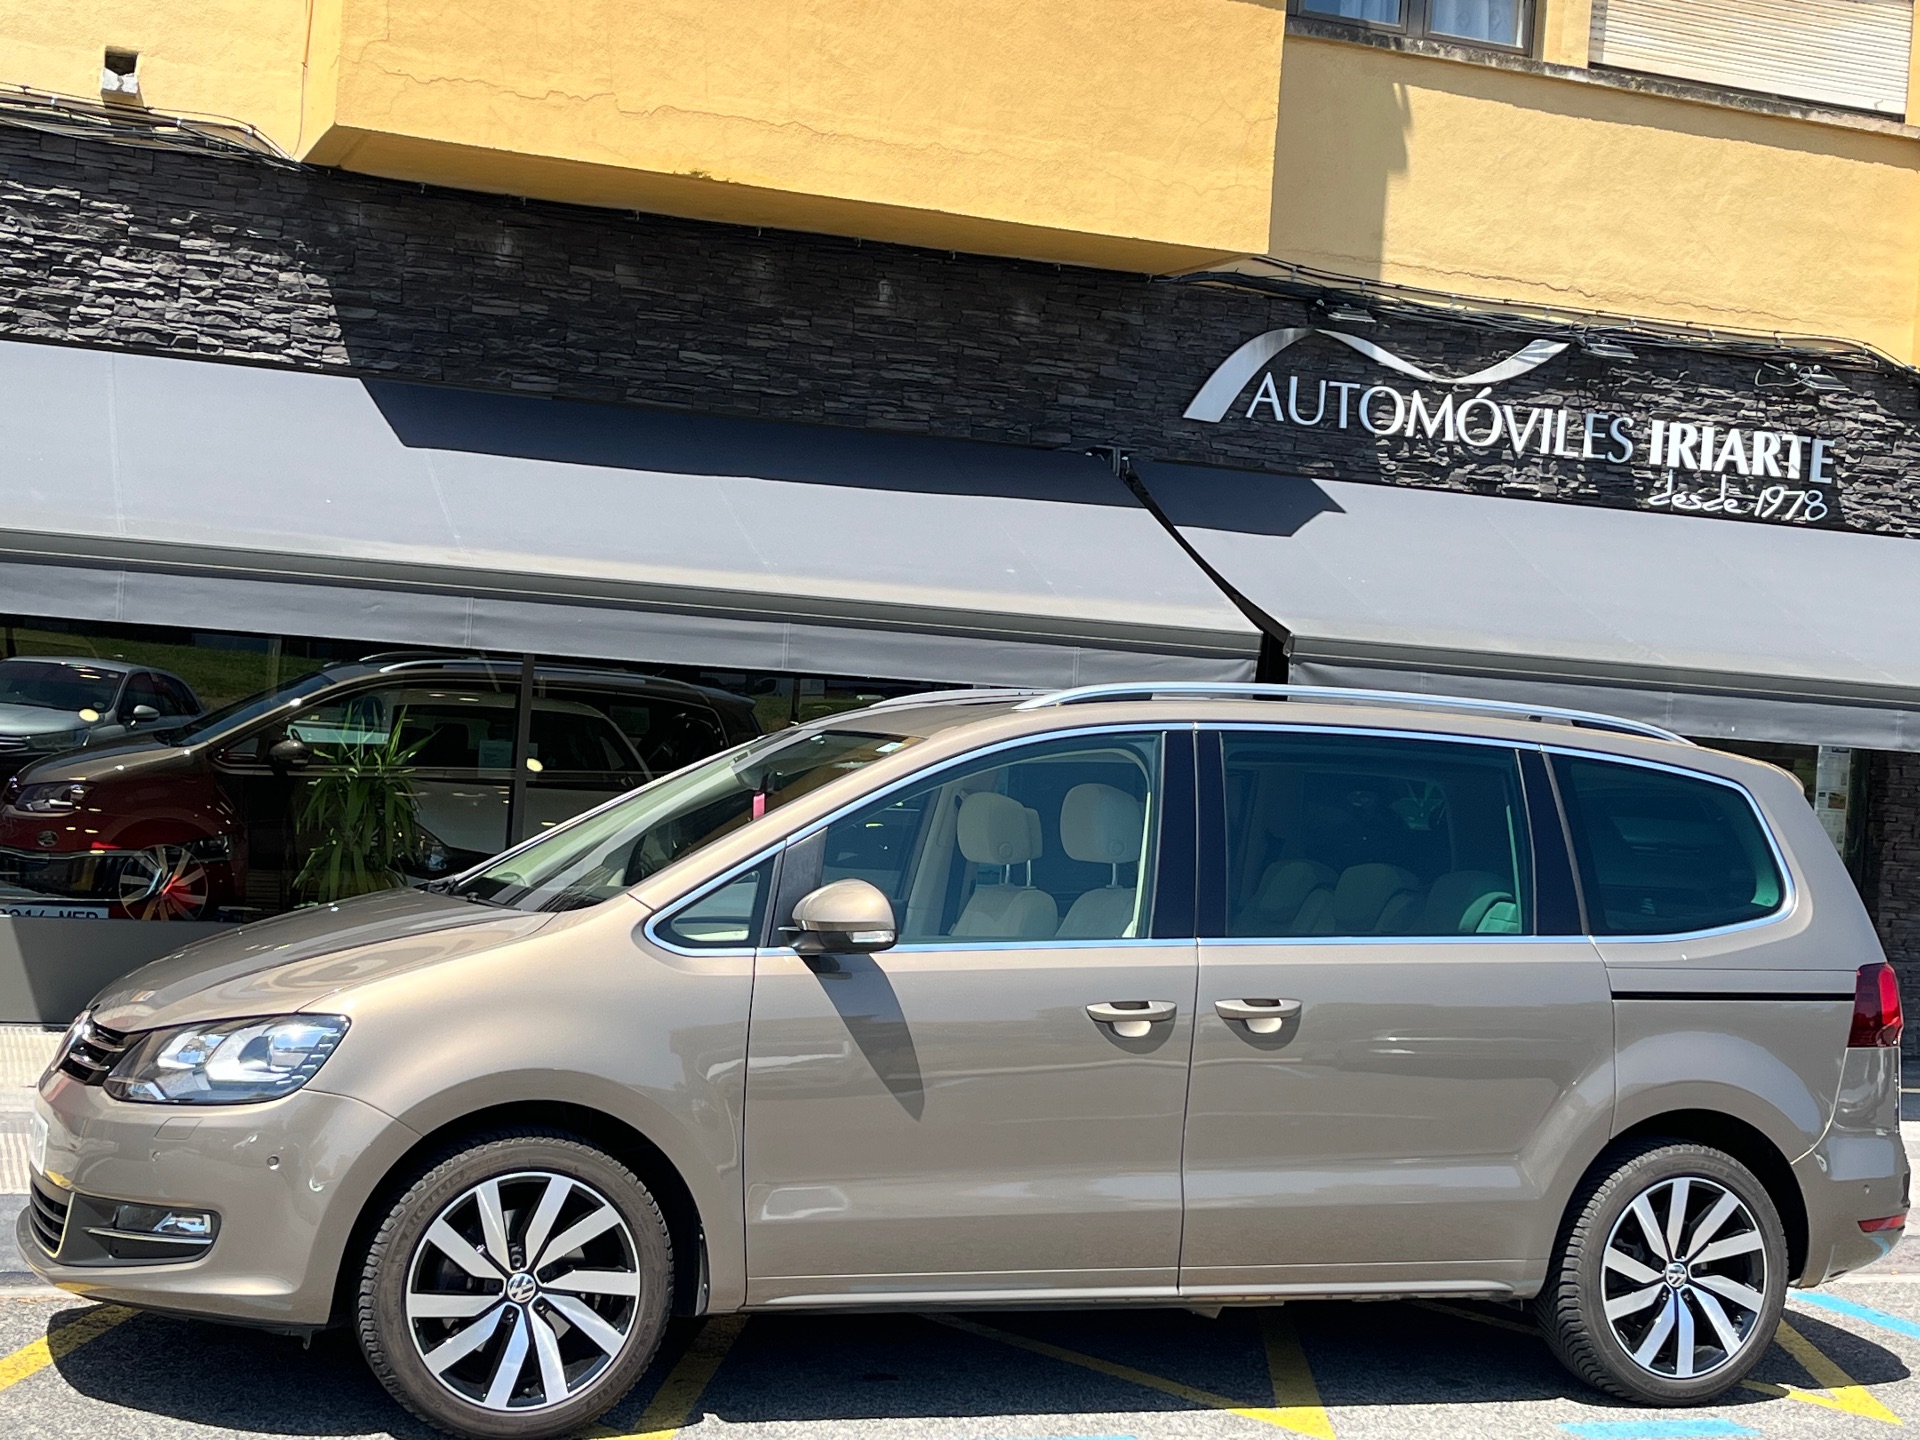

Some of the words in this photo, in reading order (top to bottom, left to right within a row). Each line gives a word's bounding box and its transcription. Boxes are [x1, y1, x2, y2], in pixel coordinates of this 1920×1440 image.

[1245, 371, 1634, 464] AUTOMÓVILES
[1649, 419, 1836, 484] IRIARTE
[1647, 468, 1749, 514] desde
[1754, 486, 1828, 522] 1978
